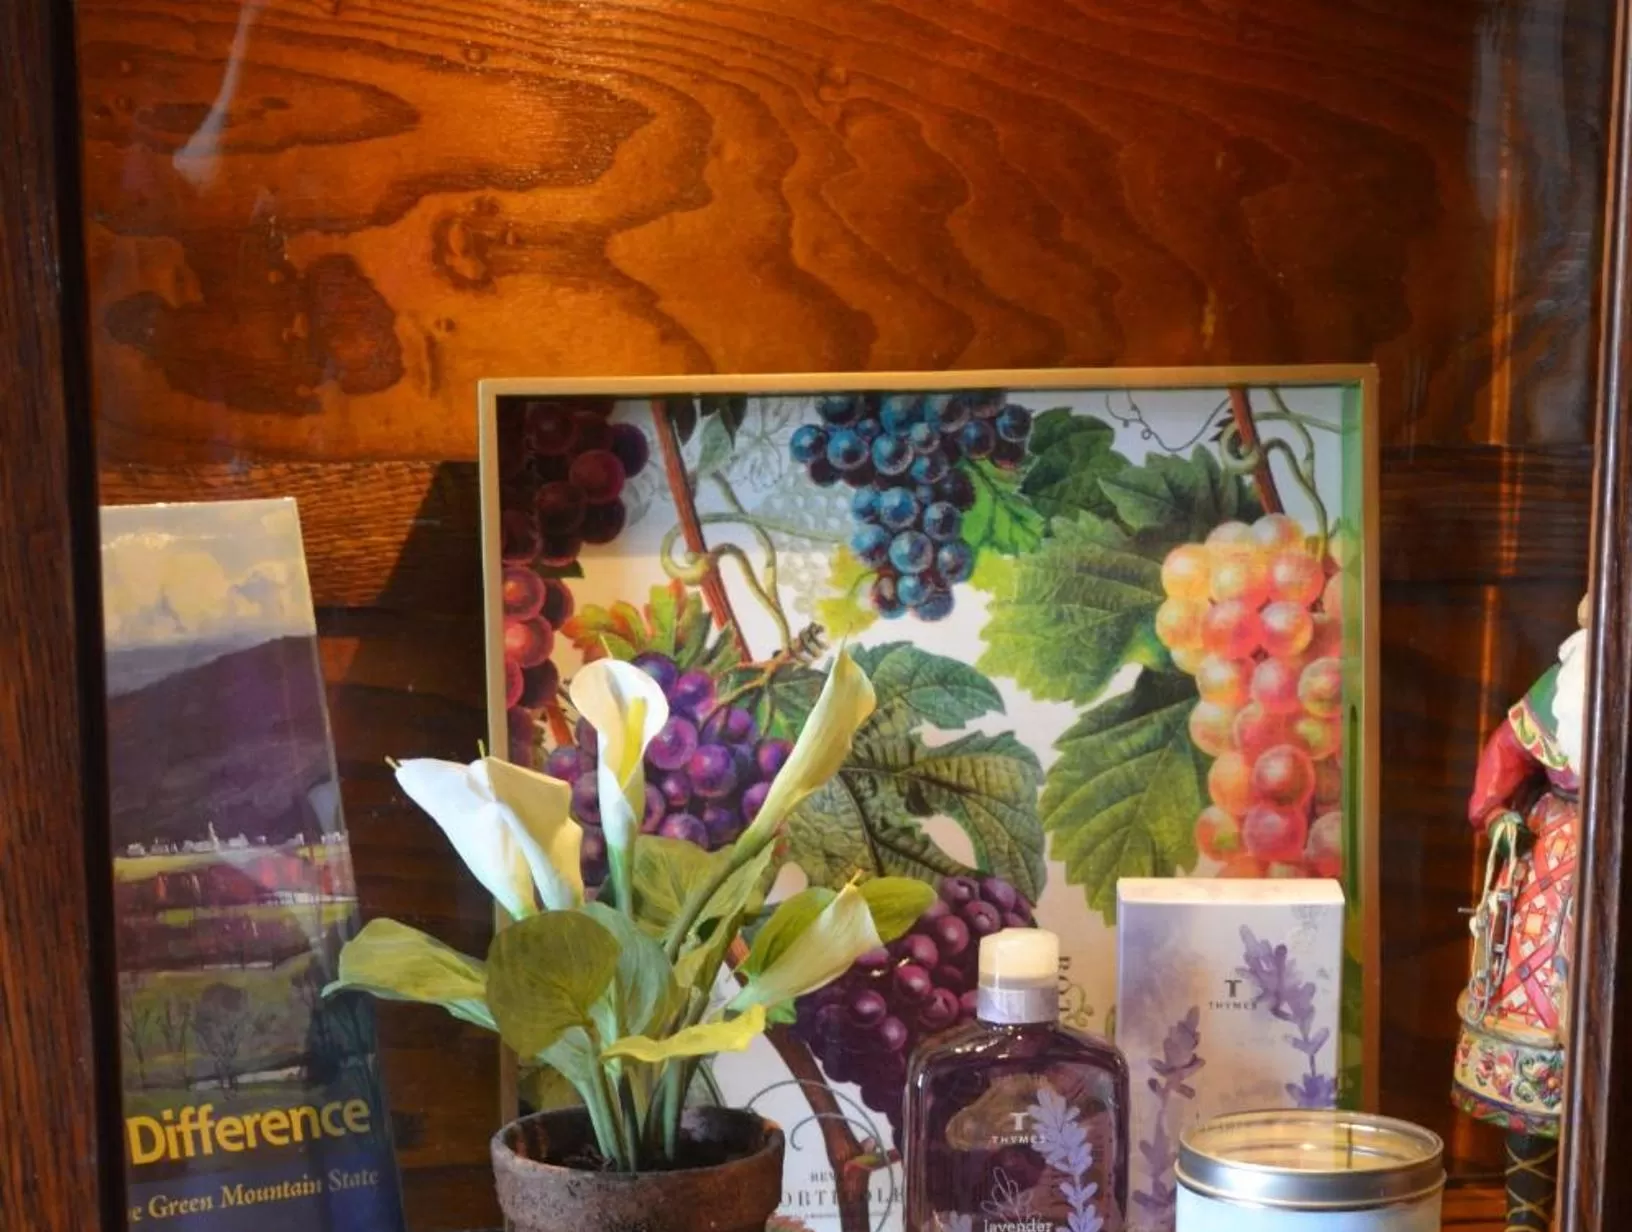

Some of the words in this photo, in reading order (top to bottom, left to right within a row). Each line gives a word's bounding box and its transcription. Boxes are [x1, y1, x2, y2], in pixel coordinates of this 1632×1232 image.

[125, 1098, 370, 1165] Difference
[149, 1194, 212, 1219] Green
[220, 1174, 322, 1209] Mountain
[328, 1168, 379, 1193] State
